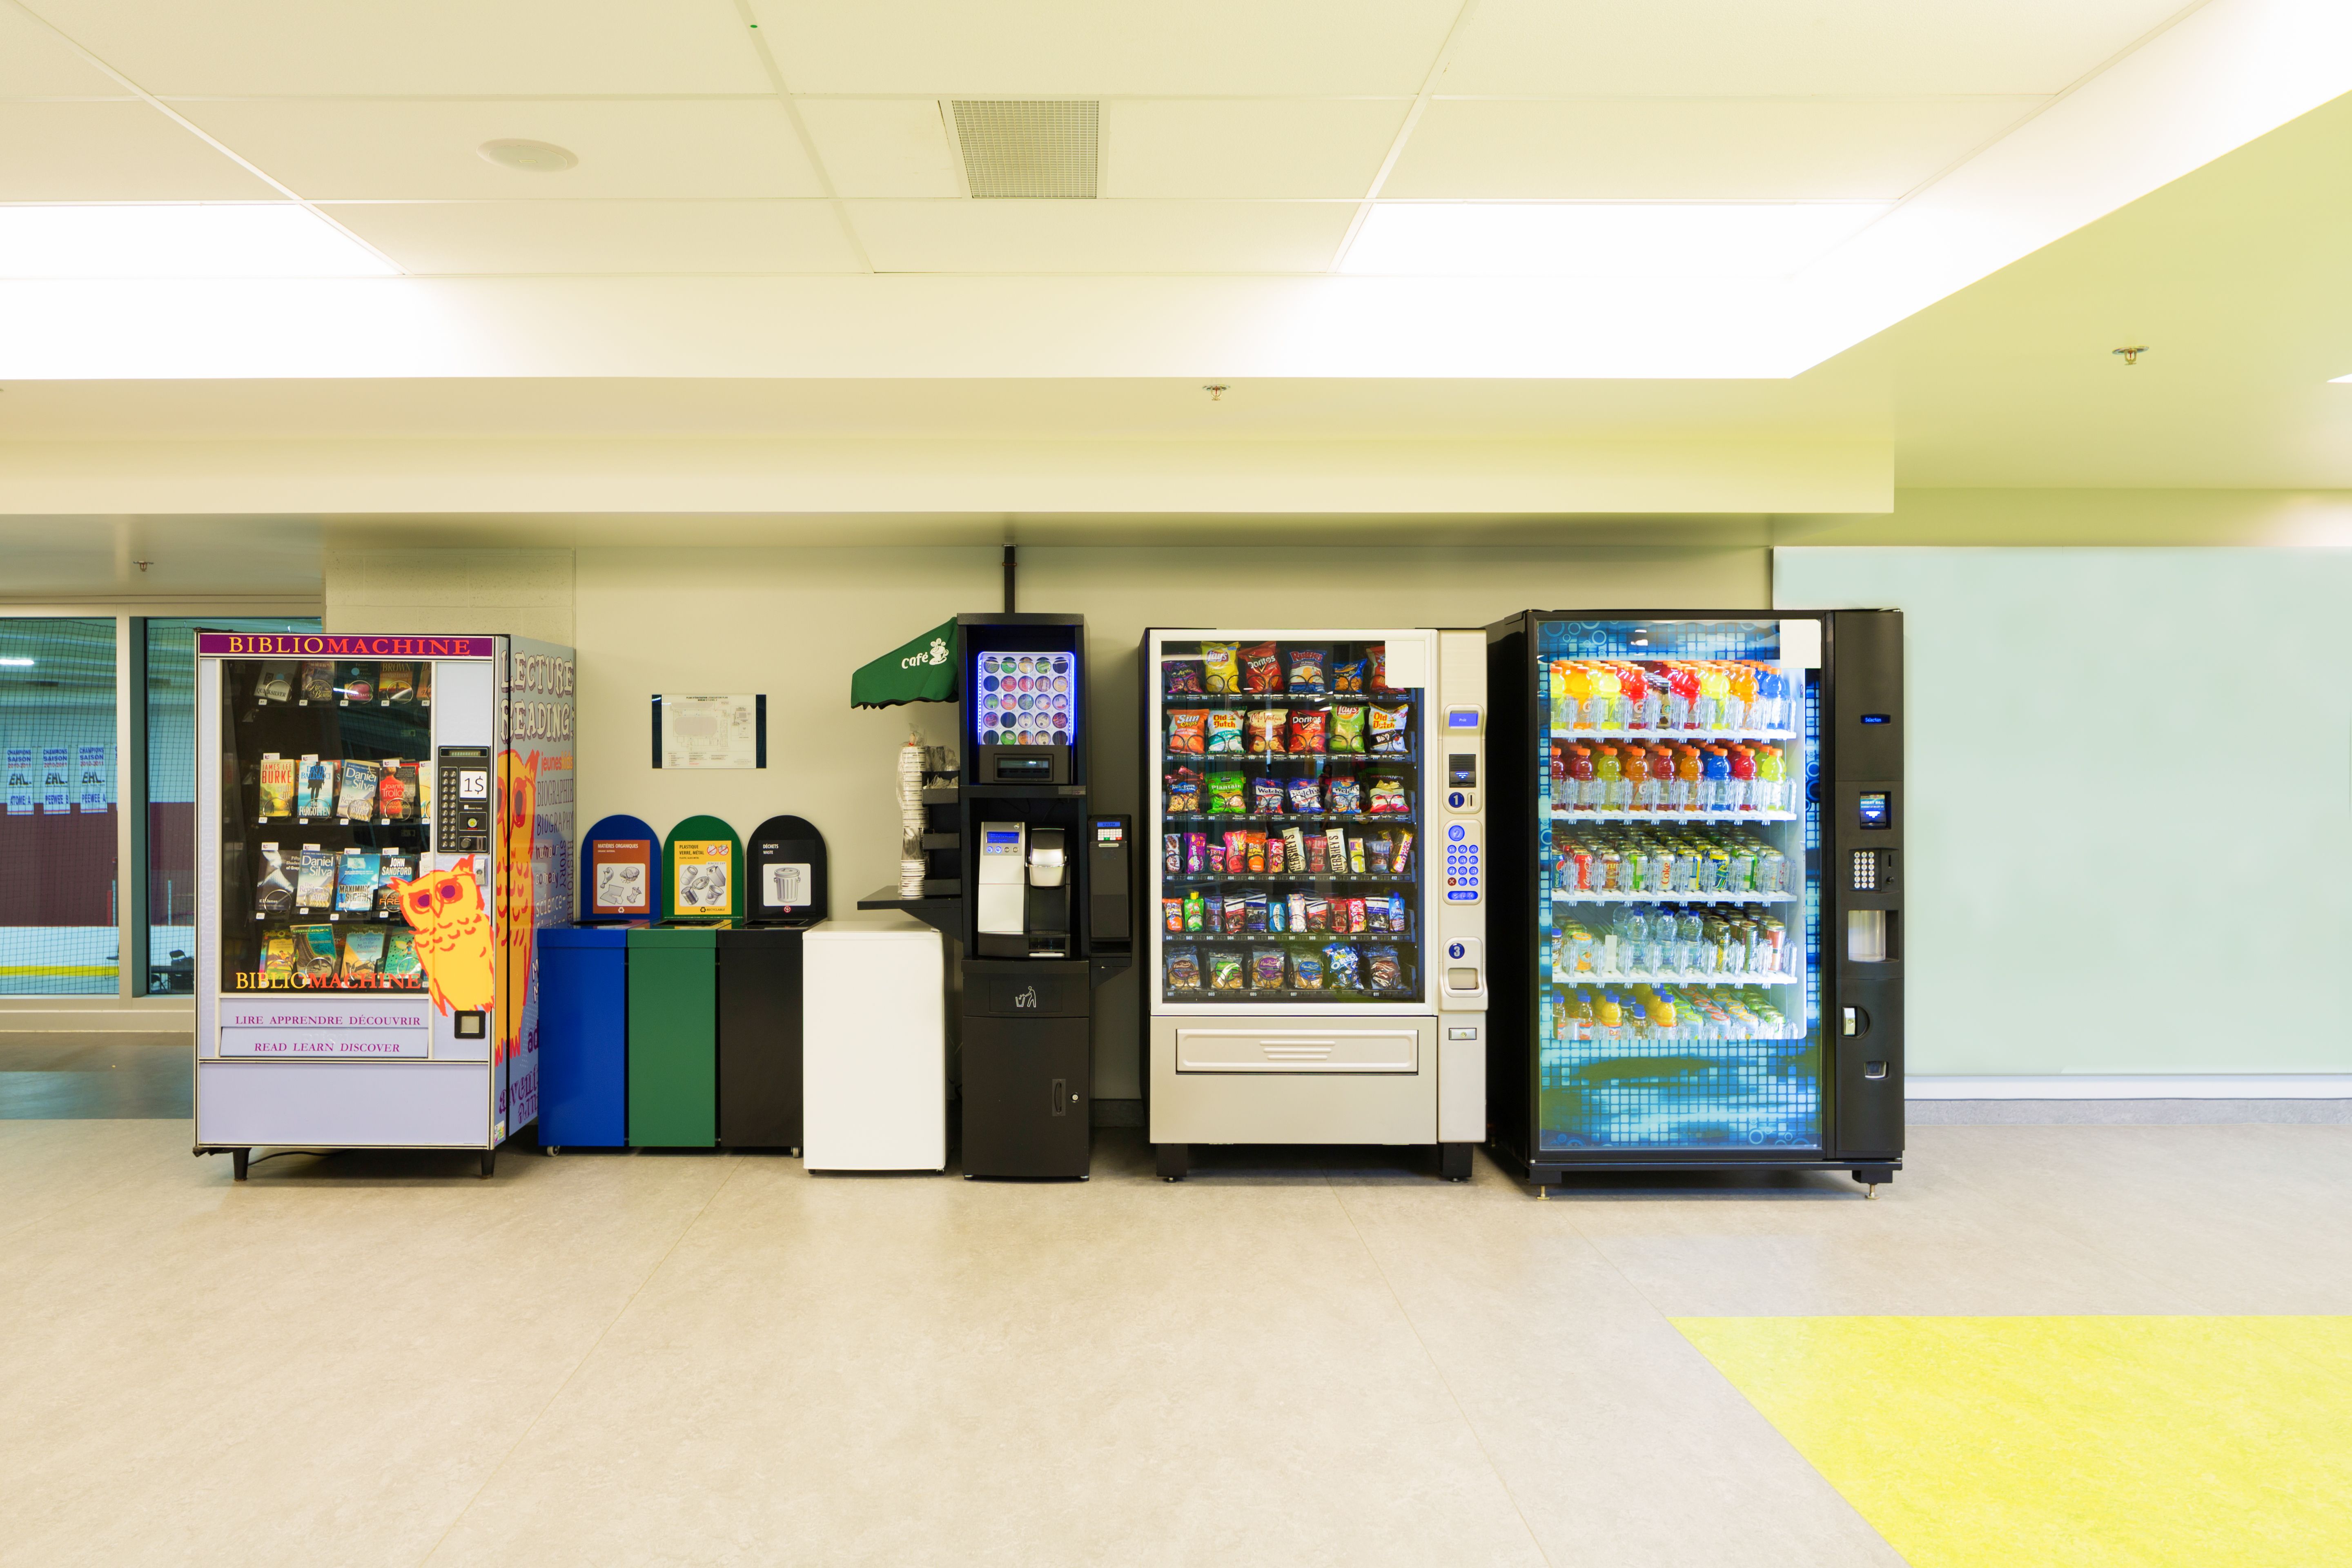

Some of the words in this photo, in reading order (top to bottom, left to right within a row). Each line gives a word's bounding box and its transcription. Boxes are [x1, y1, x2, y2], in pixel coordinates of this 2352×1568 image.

[229, 637, 470, 655] BIBLIOMACHINE
[902, 652, 928, 669] café
[1247, 655, 1276, 669] Doritos
[1290, 651, 1323, 662] Ruffles
[382, 663, 411, 672] BROWN
[501, 650, 574, 698] LECTURE
[256, 688, 286, 697] QUICKSILVER
[500, 699, 570, 744] READING
[1177, 715, 1200, 724] Sun
[1250, 713, 1263, 723] Miss
[1374, 712, 1387, 721] Old
[1376, 734, 1390, 742] BBQ
[541, 751, 573, 776] jeuneskids
[262, 771, 292, 784] BURKE
[346, 767, 376, 782] Daniel
[352, 779, 374, 792] Silva
[465, 776, 483, 795] 1$
[82, 793, 100, 803] PEEWEE
[102, 794, 106, 803] A
[382, 788, 414, 797] Trollope
[537, 779, 573, 806] BIOGRAPHIE
[28, 795, 31, 804] A
[45, 795, 63, 804] PEEWEE
[341, 797, 370, 807] Rembrandt
[1453, 795, 1458, 805] 1
[299, 806, 329, 816] FORGOTTEN
[537, 811, 573, 836] BIOGRAPHY
[1454, 829, 1460, 839] 2
[536, 844, 559, 860] humour
[1285, 834, 1301, 871] HERSHEY'S
[1329, 835, 1343, 872] HERSHEY'S
[302, 855, 334, 867] Daniel
[390, 858, 405, 867] JOHN
[310, 866, 332, 877] Silva
[381, 867, 412, 876] SANDFORD
[1662, 862, 1670, 885] Coke
[535, 868, 558, 889] comedy
[339, 884, 370, 893] MAXIMUM
[536, 893, 566, 918] science-
[1454, 946, 1460, 957] 3
[236, 972, 421, 989] BIBLIOMACHINE
[235, 1016, 263, 1025] LIRE
[270, 1016, 343, 1025] APPRENDRE
[349, 1015, 421, 1025] DÉCOUVRIR
[254, 1043, 287, 1051] READ
[293, 1043, 334, 1052] LEARN
[341, 1043, 400, 1052] DISCOVER
